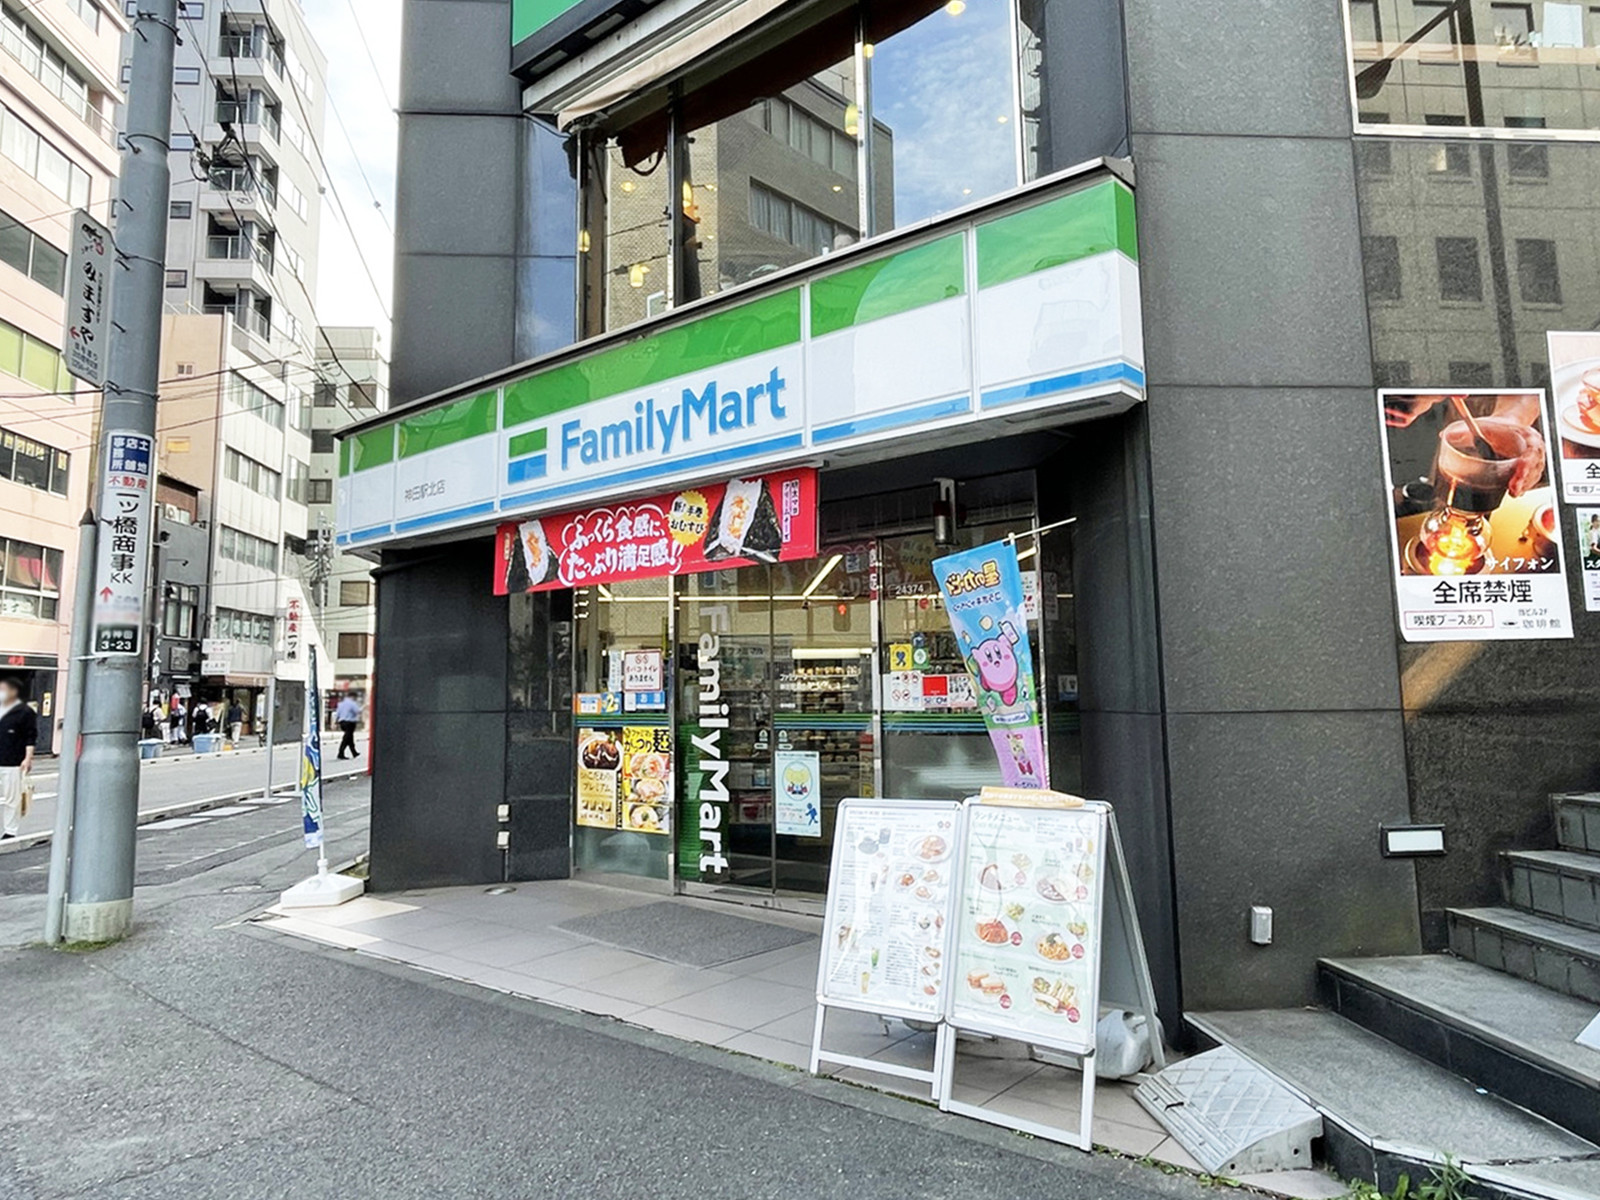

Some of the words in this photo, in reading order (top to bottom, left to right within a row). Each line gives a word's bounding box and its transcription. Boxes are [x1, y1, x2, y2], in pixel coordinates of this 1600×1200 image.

[561, 366, 788, 471] FamilyMart
[108, 475, 148, 489] 不動産
[671, 519, 704, 534] おむすび
[1485, 556, 1554, 571] サイフォン
[1433, 579, 1534, 604] 全席禁煙
[1413, 613, 1486, 627] 喫煙ブースあり
[101, 640, 132, 650] 3-23
[691, 604, 729, 874] FamilyMart
